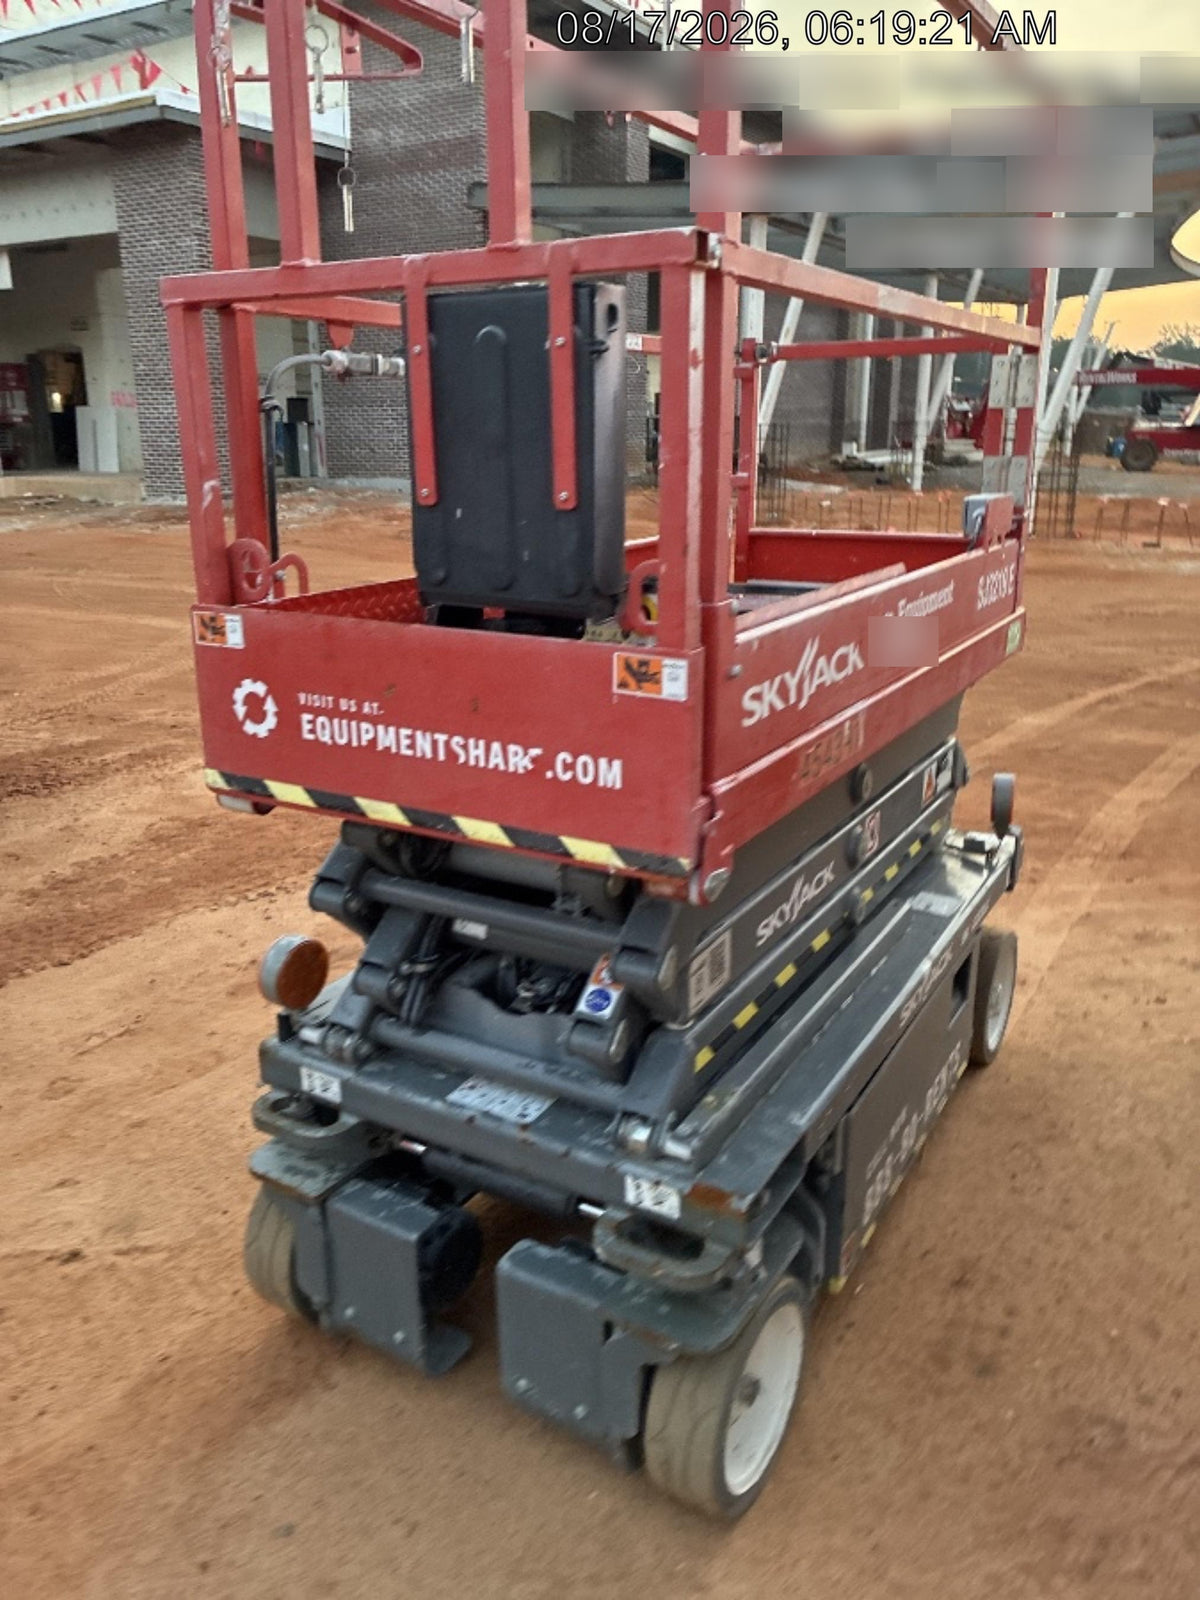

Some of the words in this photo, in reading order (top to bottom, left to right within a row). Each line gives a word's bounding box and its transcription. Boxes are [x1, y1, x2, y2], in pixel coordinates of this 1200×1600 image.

[297, 692, 334, 710] VISIT
[339, 697, 358, 713] US
[741, 635, 865, 728] SKYJACK
